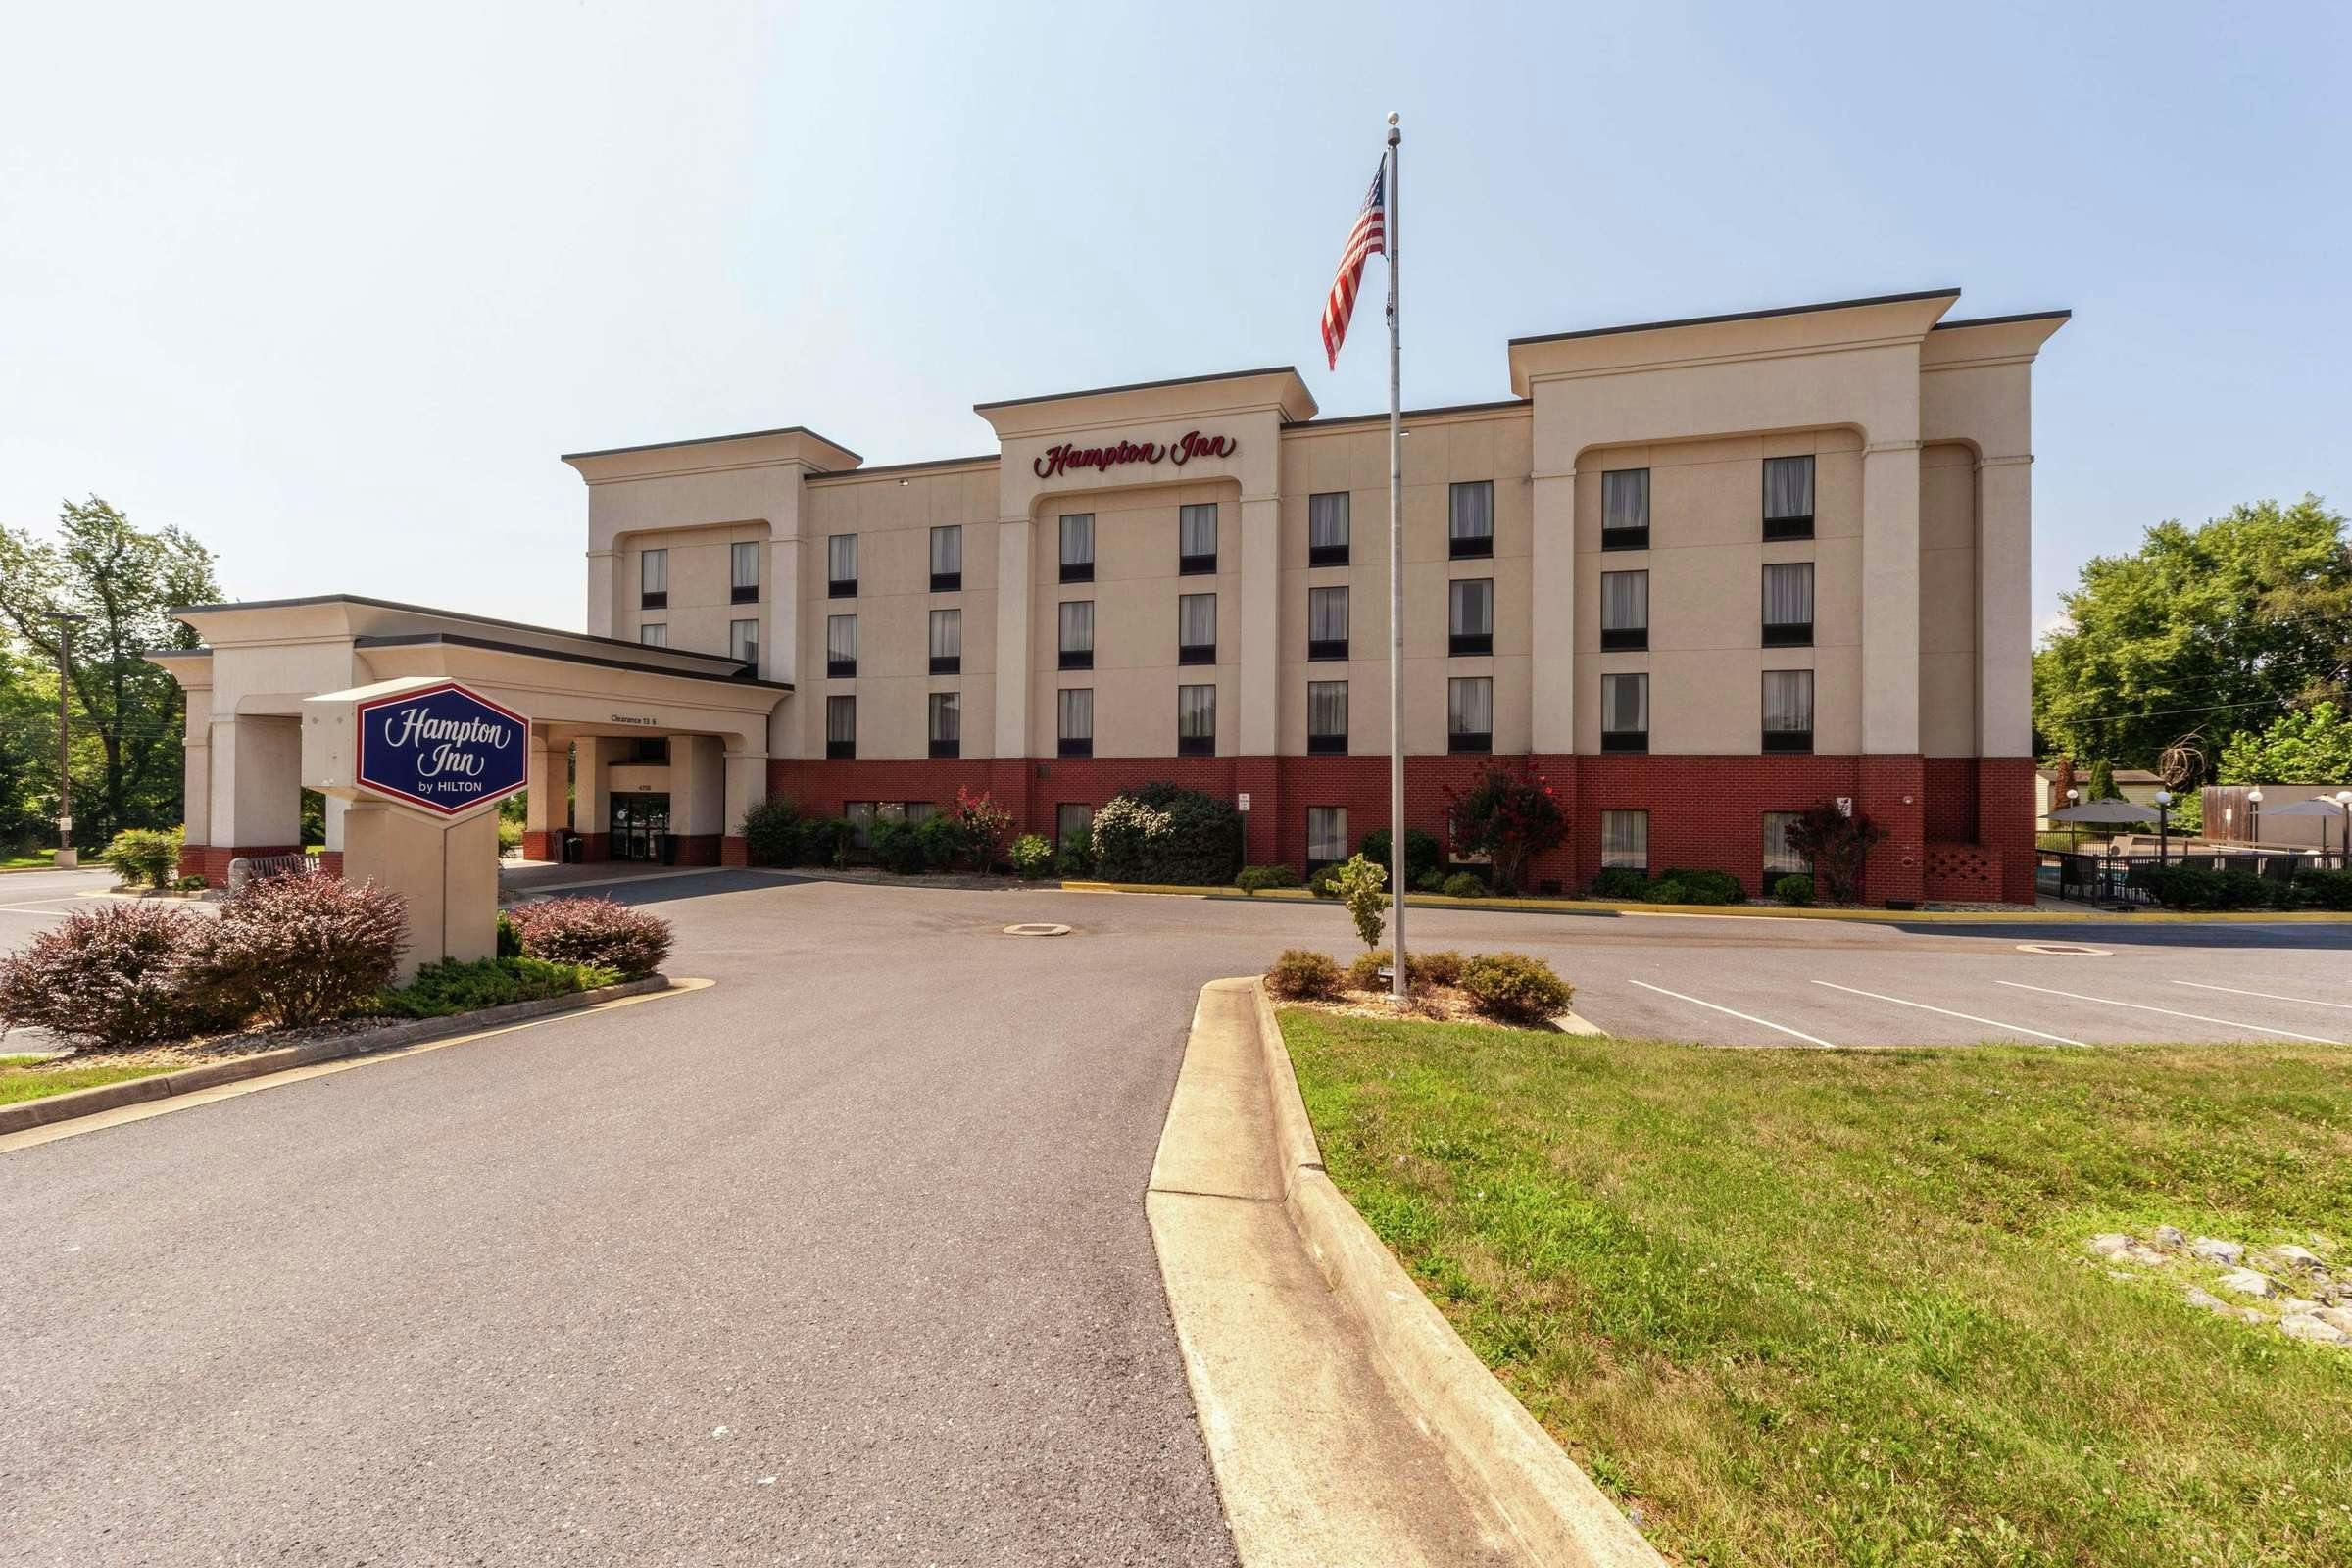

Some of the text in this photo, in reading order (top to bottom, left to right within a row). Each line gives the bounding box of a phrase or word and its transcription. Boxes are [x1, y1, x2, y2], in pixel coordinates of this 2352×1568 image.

[1033, 430, 1237, 479] Hampton Inn
[384, 707, 511, 749] Hampton
[417, 743, 485, 777] Inn
[418, 782, 482, 794] by HILTON
